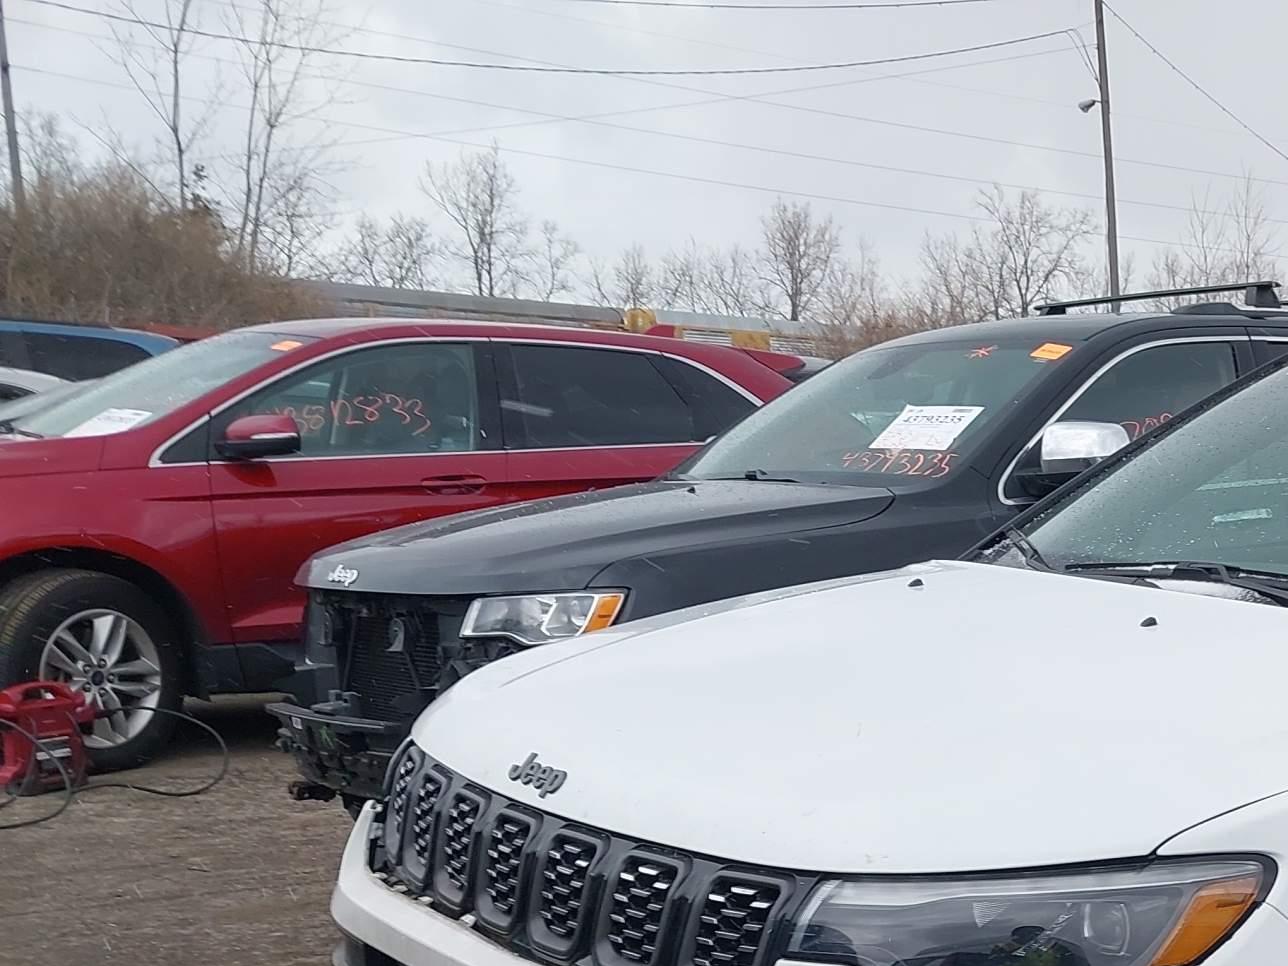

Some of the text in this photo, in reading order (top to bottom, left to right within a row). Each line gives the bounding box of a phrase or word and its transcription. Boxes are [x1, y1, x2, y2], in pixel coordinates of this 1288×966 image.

[262, 392, 432, 436] 3812833
[328, 564, 359, 587] Jeep
[508, 752, 568, 800] Jeep
